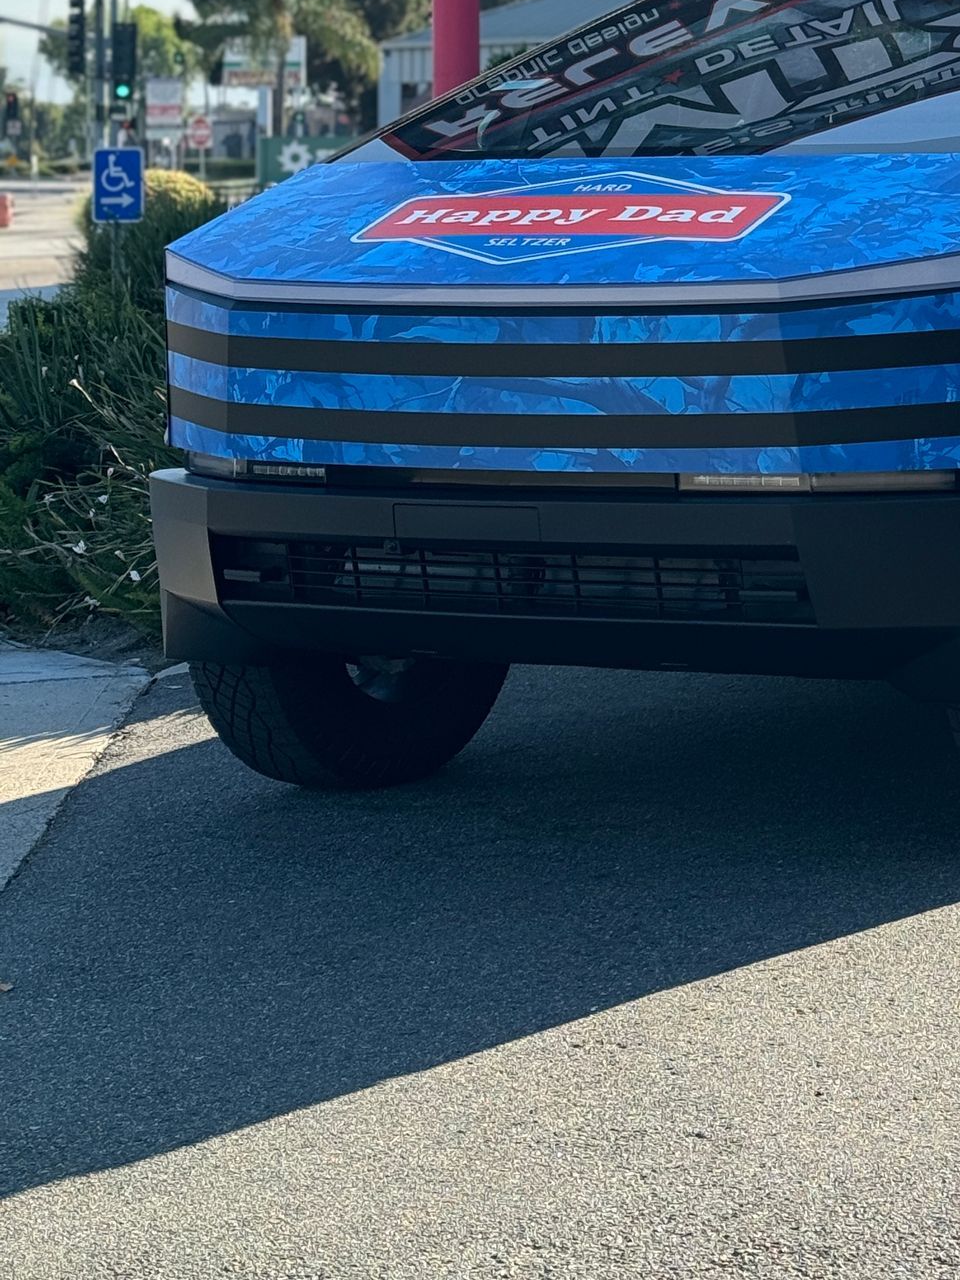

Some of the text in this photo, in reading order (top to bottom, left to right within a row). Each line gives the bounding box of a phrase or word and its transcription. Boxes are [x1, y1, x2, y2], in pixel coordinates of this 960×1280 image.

[573, 183, 632, 194] HARD
[394, 205, 747, 227] Happy Dad
[484, 237, 571, 248] SELTZER
